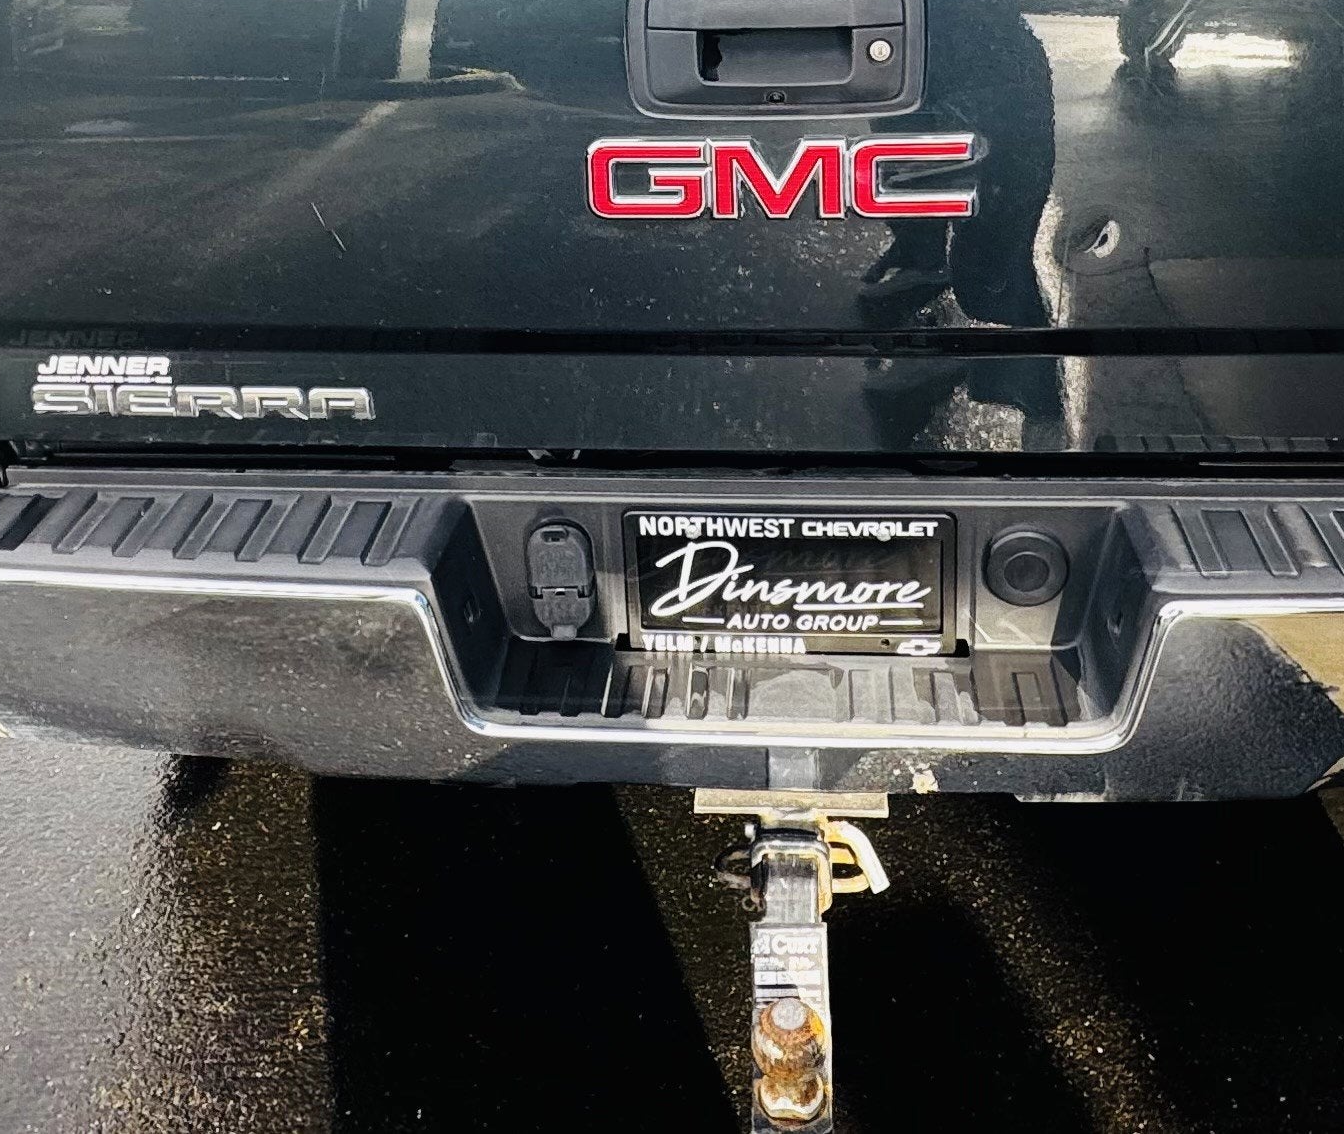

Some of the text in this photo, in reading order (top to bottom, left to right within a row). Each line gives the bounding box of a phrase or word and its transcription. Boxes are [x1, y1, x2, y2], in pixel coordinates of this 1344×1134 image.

[587, 134, 977, 220] GMC
[37, 354, 171, 376] JENNER
[32, 384, 376, 420] SIERRA
[639, 516, 939, 540] NORTHWEST CHEVROLET
[650, 540, 932, 617] Dinsmore
[726, 614, 880, 632] AUTO GROUP
[642, 634, 694, 652] YELM
